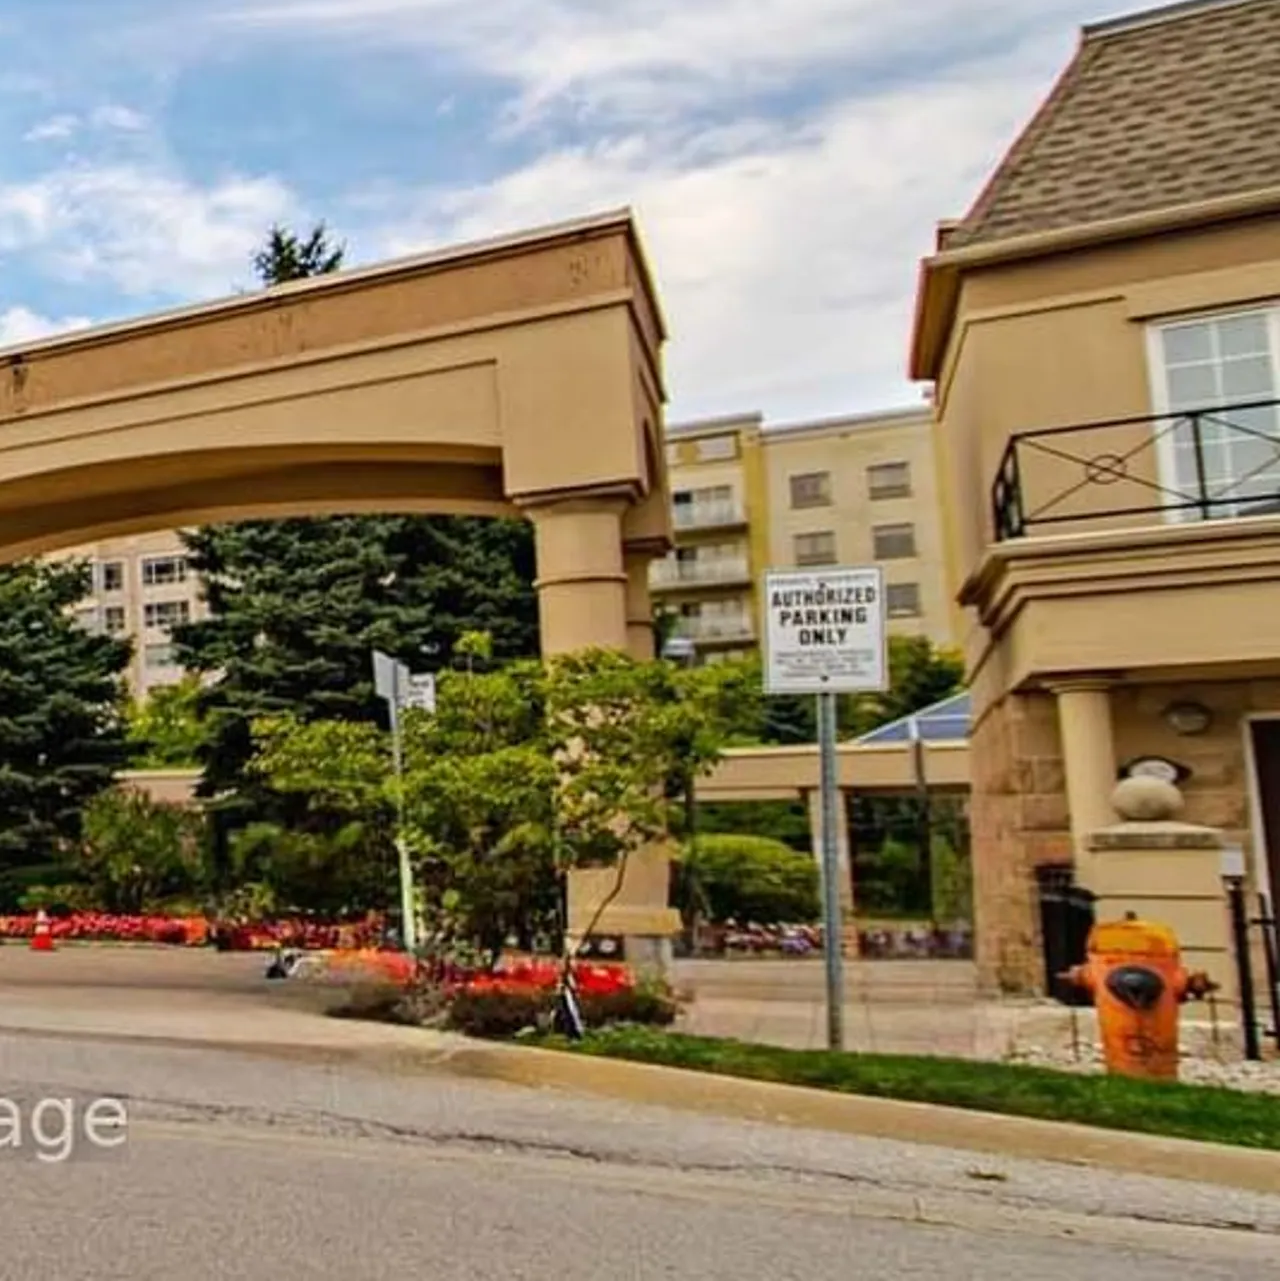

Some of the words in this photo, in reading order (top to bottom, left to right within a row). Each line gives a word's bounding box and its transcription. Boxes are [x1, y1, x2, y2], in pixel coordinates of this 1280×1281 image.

[772, 586, 876, 607] AUTHORIZED
[779, 606, 868, 626] PARKING
[798, 628, 847, 646] ONLY
